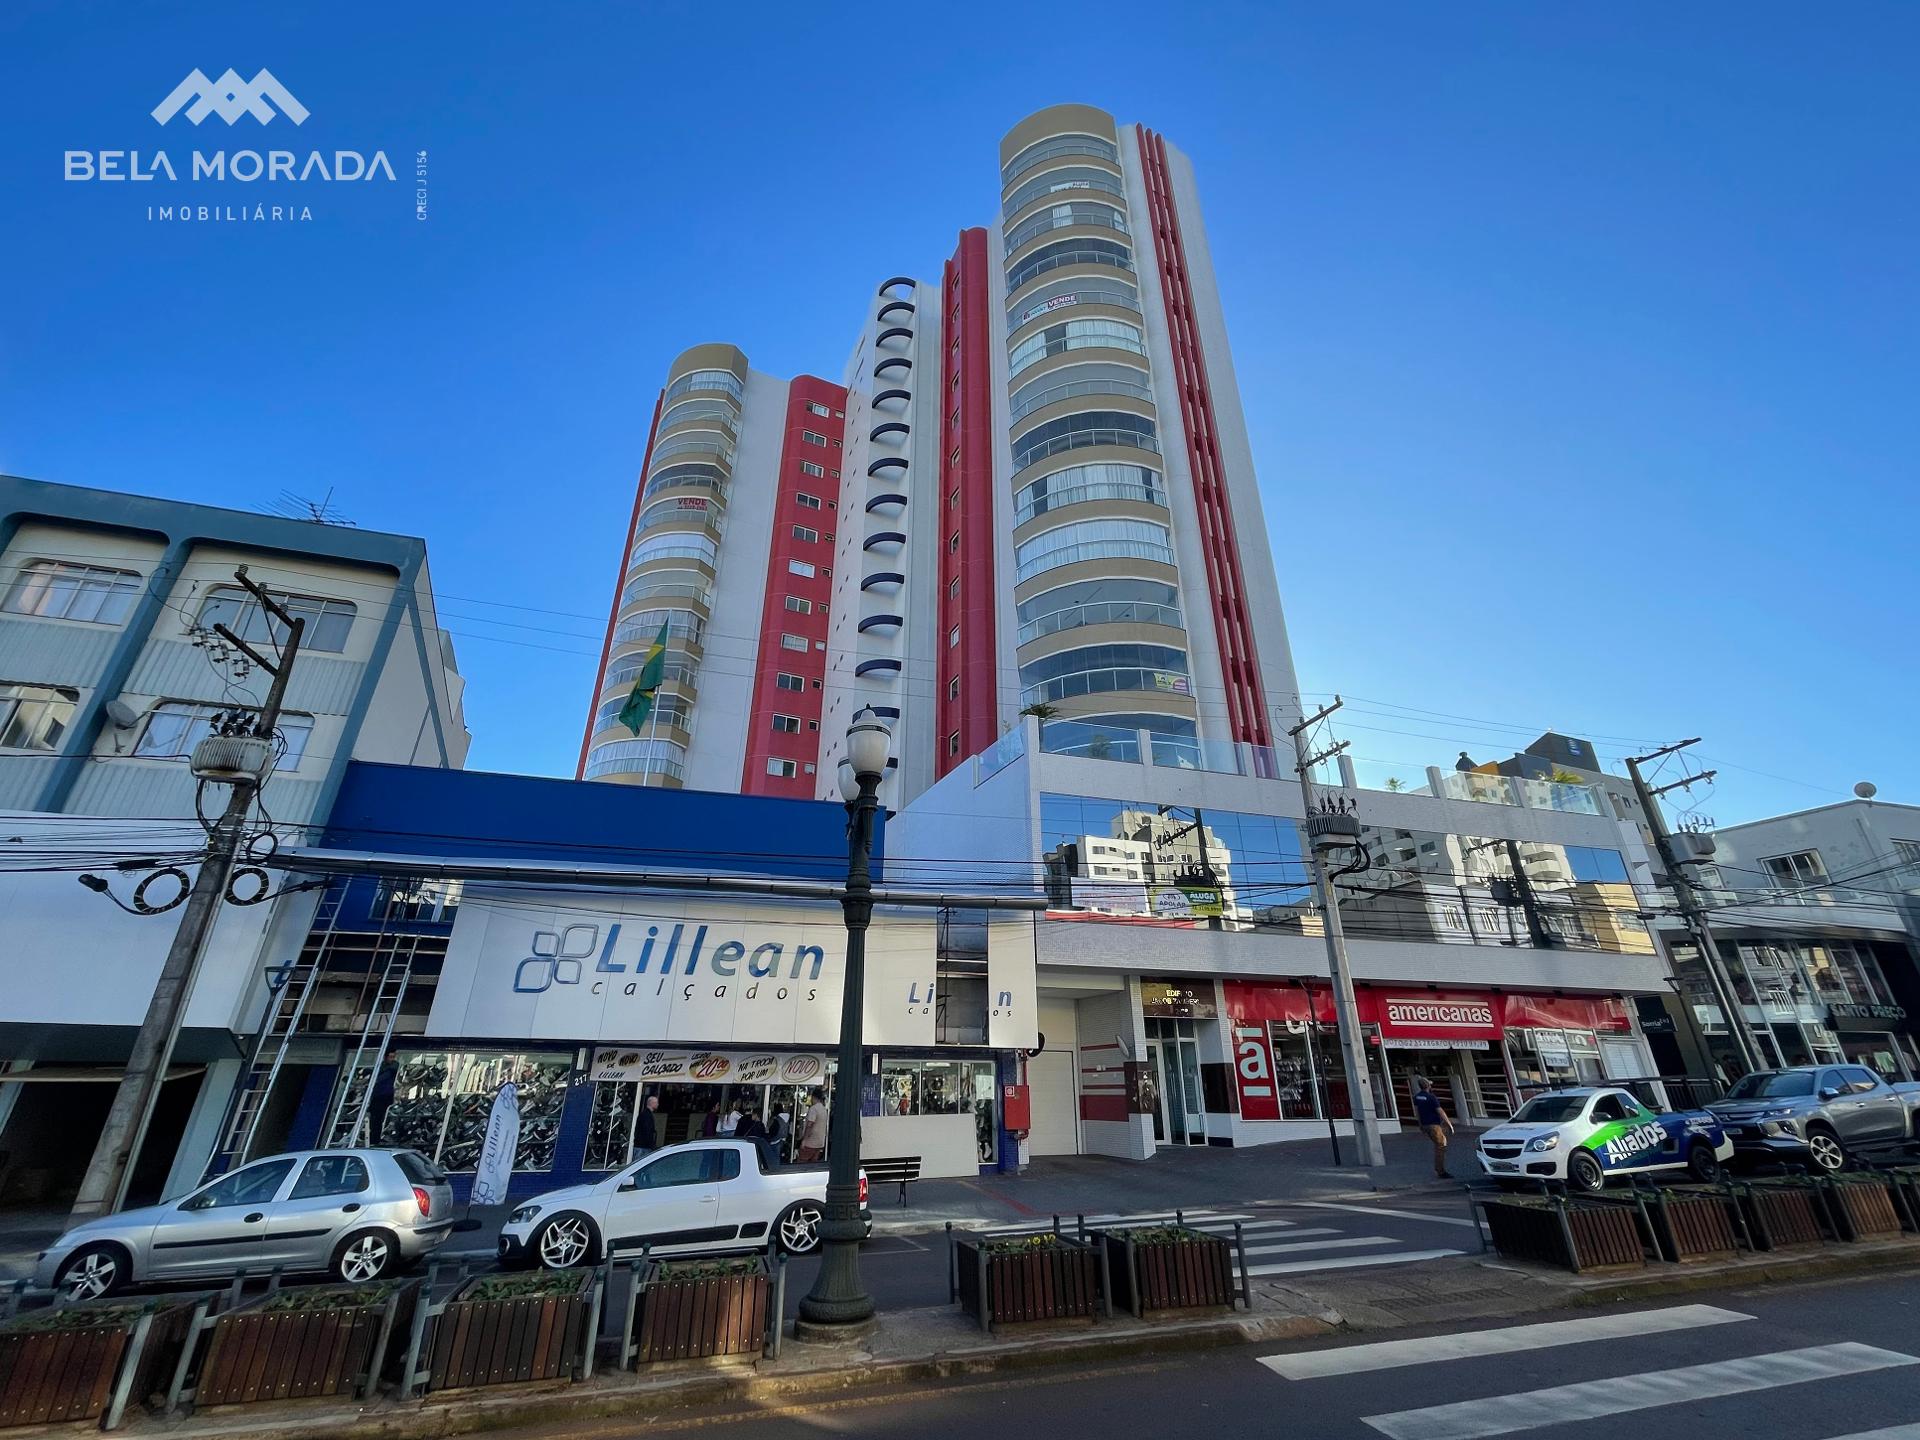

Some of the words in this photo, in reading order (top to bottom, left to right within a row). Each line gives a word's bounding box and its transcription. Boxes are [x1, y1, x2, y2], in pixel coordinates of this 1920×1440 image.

[1048, 295, 1076, 306] VENDE
[1190, 892, 1215, 900] ALUGA
[596, 923, 825, 980] Lillean
[591, 978, 817, 1001] calçados
[1388, 1005, 1493, 1023] americanas
[641, 1063, 683, 1076] CALÇADO
[643, 1052, 664, 1065] SEU
[738, 1061, 749, 1072] NA
[785, 1059, 816, 1074] NOVO
[575, 1074, 587, 1086] 217
[487, 1114, 502, 1158] Lillean
[1603, 1121, 1668, 1165] Aliados
